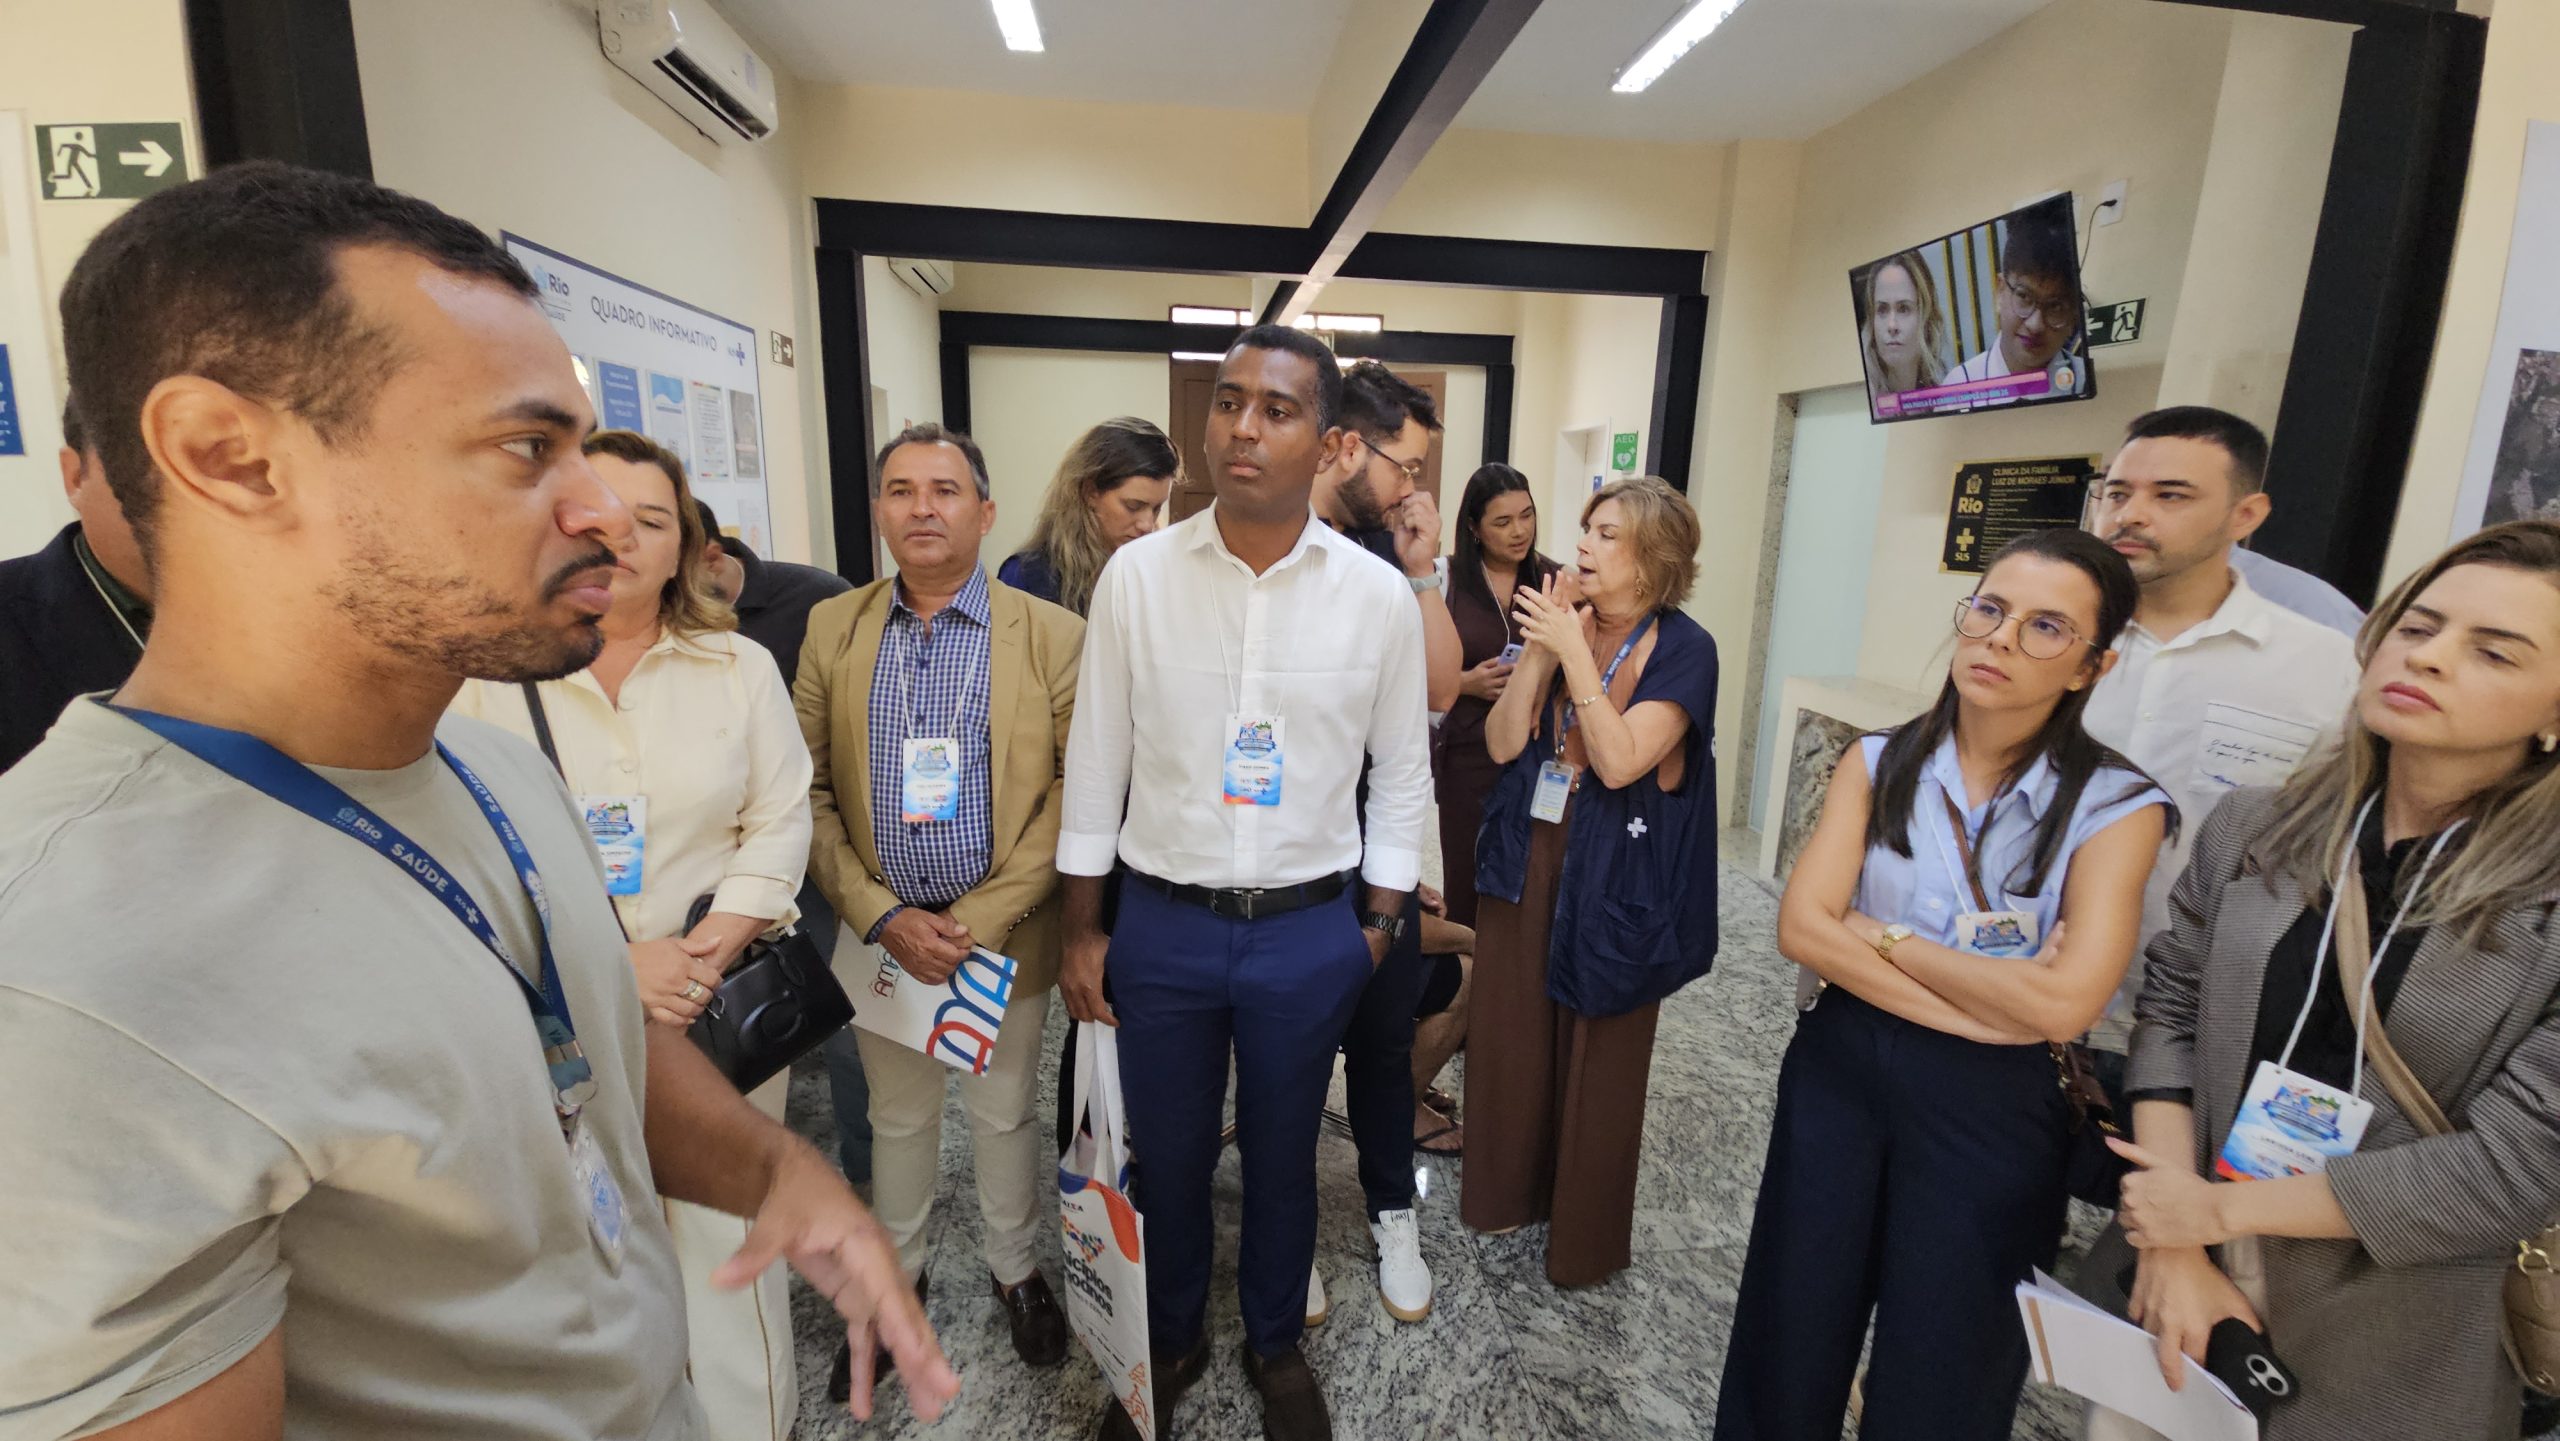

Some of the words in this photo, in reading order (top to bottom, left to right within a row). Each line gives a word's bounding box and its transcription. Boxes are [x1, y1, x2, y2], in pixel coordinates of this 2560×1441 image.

[548, 272, 569, 296] Rio
[590, 295, 646, 329] QUADRO
[648, 315, 717, 351] INFORMATIVO
[1615, 434, 1636, 444] AED
[1957, 496, 1984, 514] Rio
[460, 766, 499, 813] SAÚDE
[353, 817, 382, 840] Rio
[391, 843, 448, 893] SAÚDE
